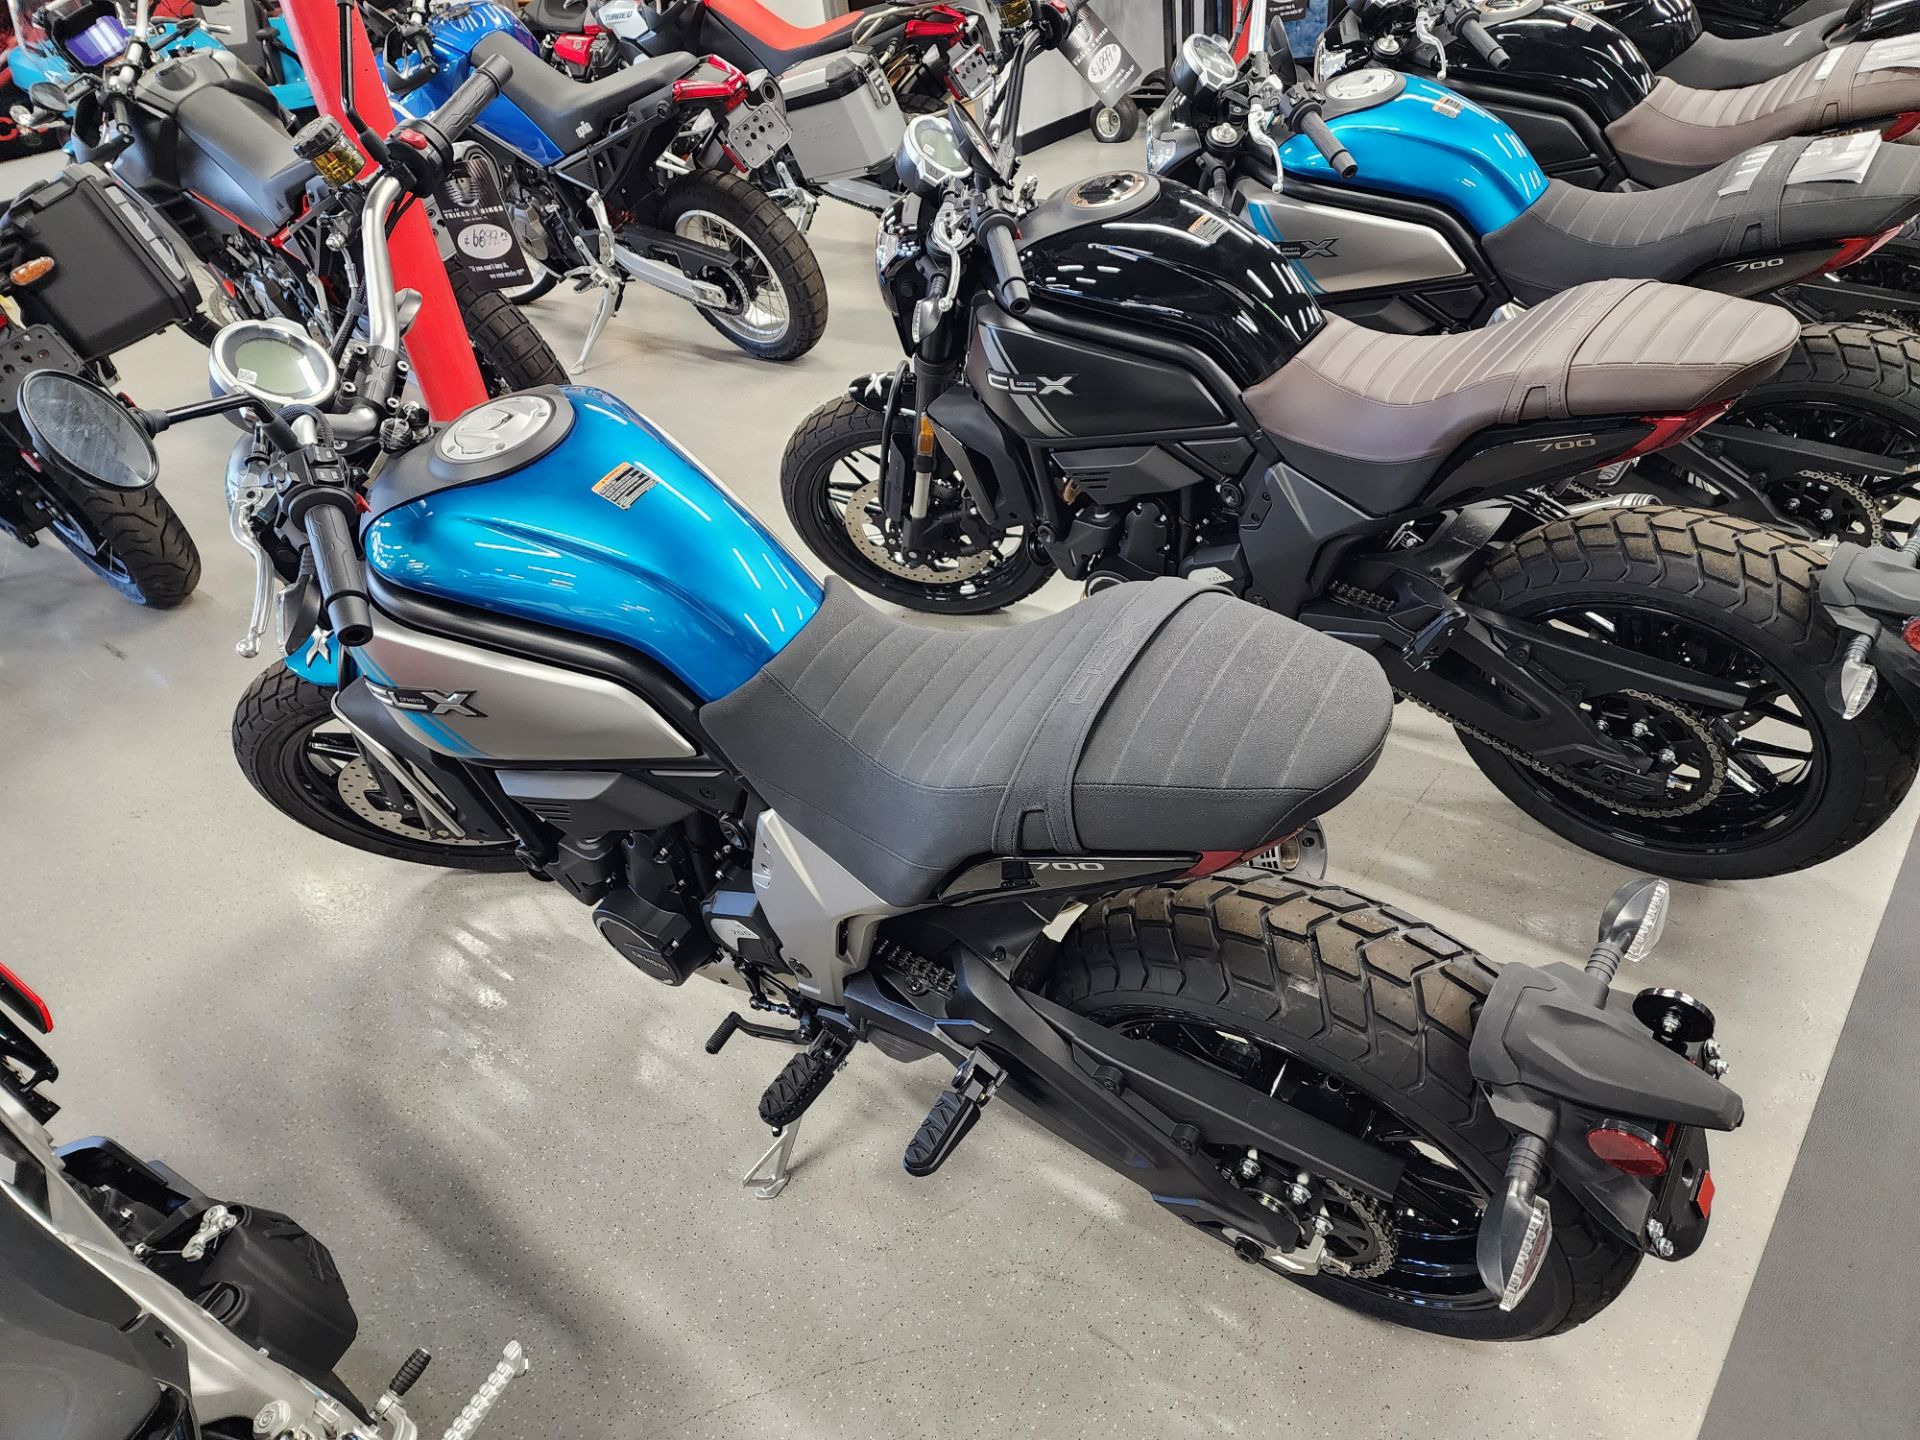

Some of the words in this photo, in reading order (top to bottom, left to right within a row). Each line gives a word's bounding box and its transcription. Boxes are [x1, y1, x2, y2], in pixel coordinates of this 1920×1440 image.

[1735, 258, 1784, 272] 700
[987, 372, 1074, 395] CLX
[1536, 438, 1596, 452] 700
[1028, 861, 1105, 871] 700
